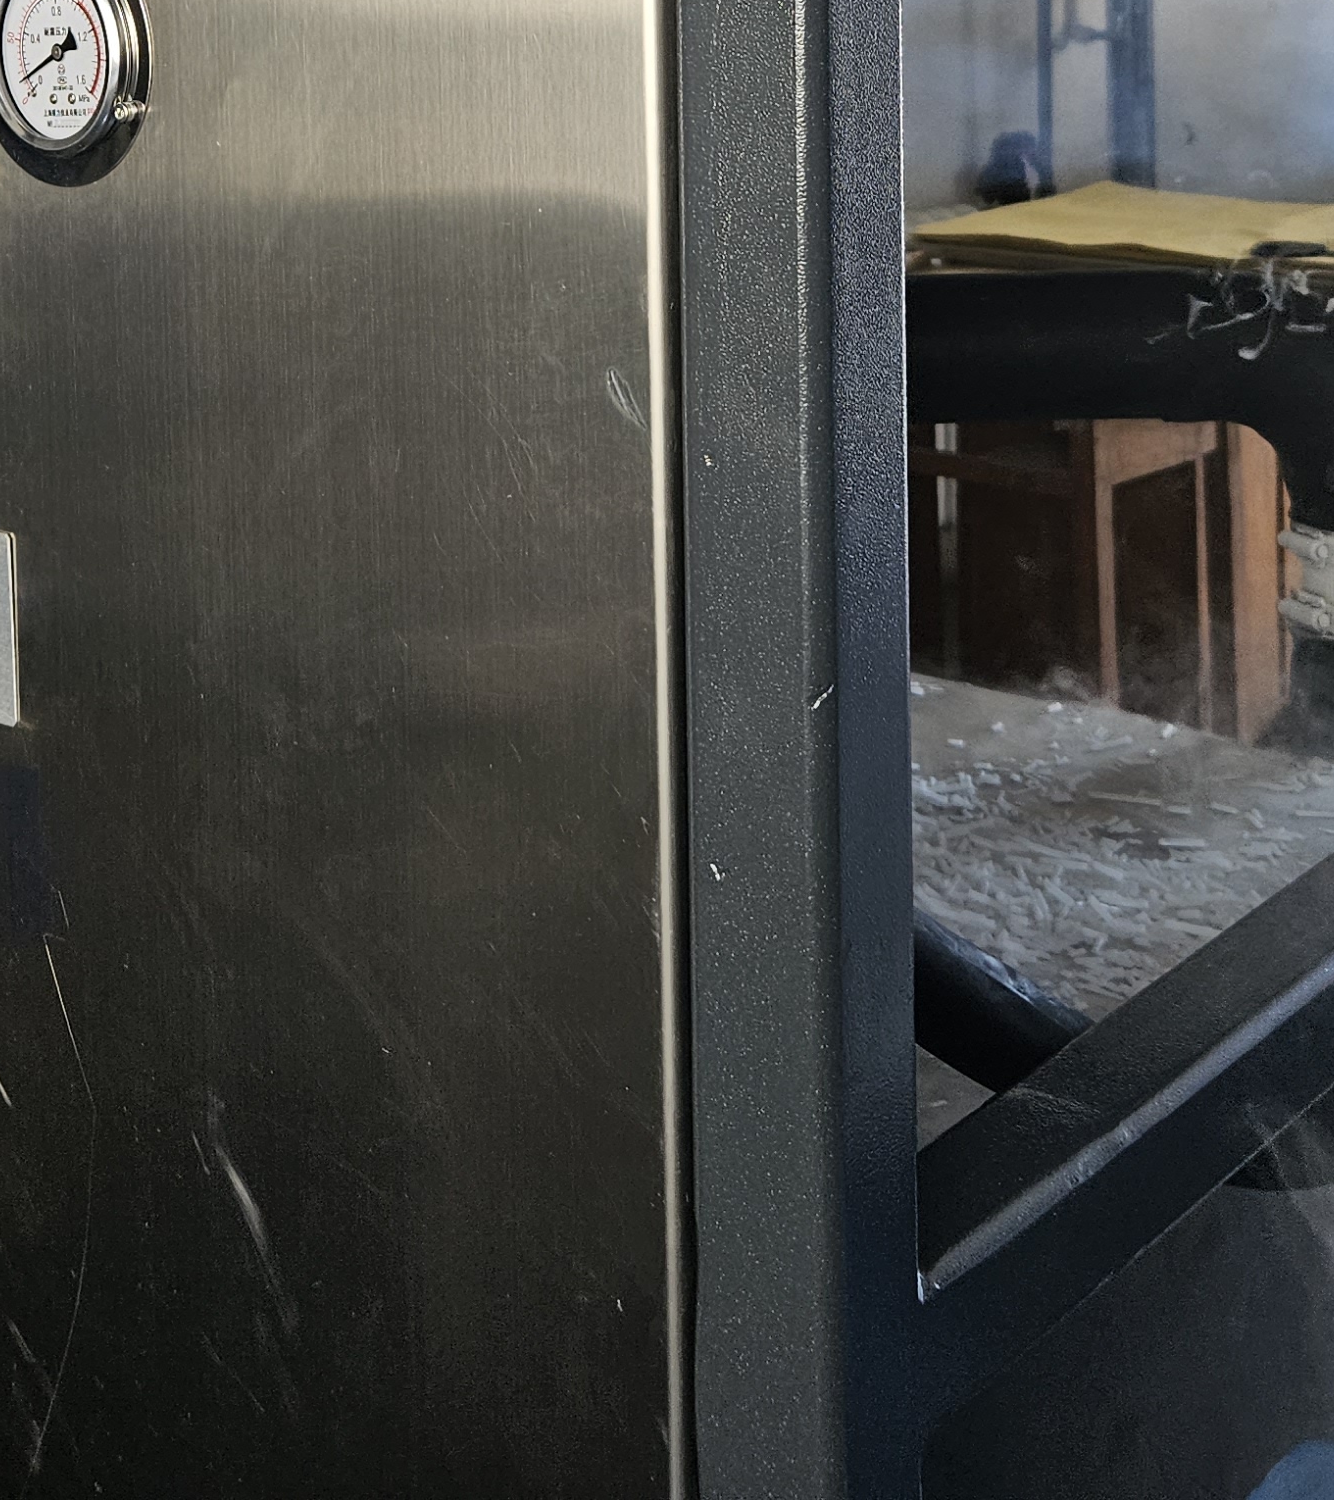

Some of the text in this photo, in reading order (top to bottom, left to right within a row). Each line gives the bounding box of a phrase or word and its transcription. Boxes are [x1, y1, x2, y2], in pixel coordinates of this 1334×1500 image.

[51, 5, 62, 16] 0.8
[30, 33, 41, 44] 0.4
[78, 31, 88, 42] 1.2
[77, 75, 87, 85] 1.6
[78, 94, 90, 102] MPa
